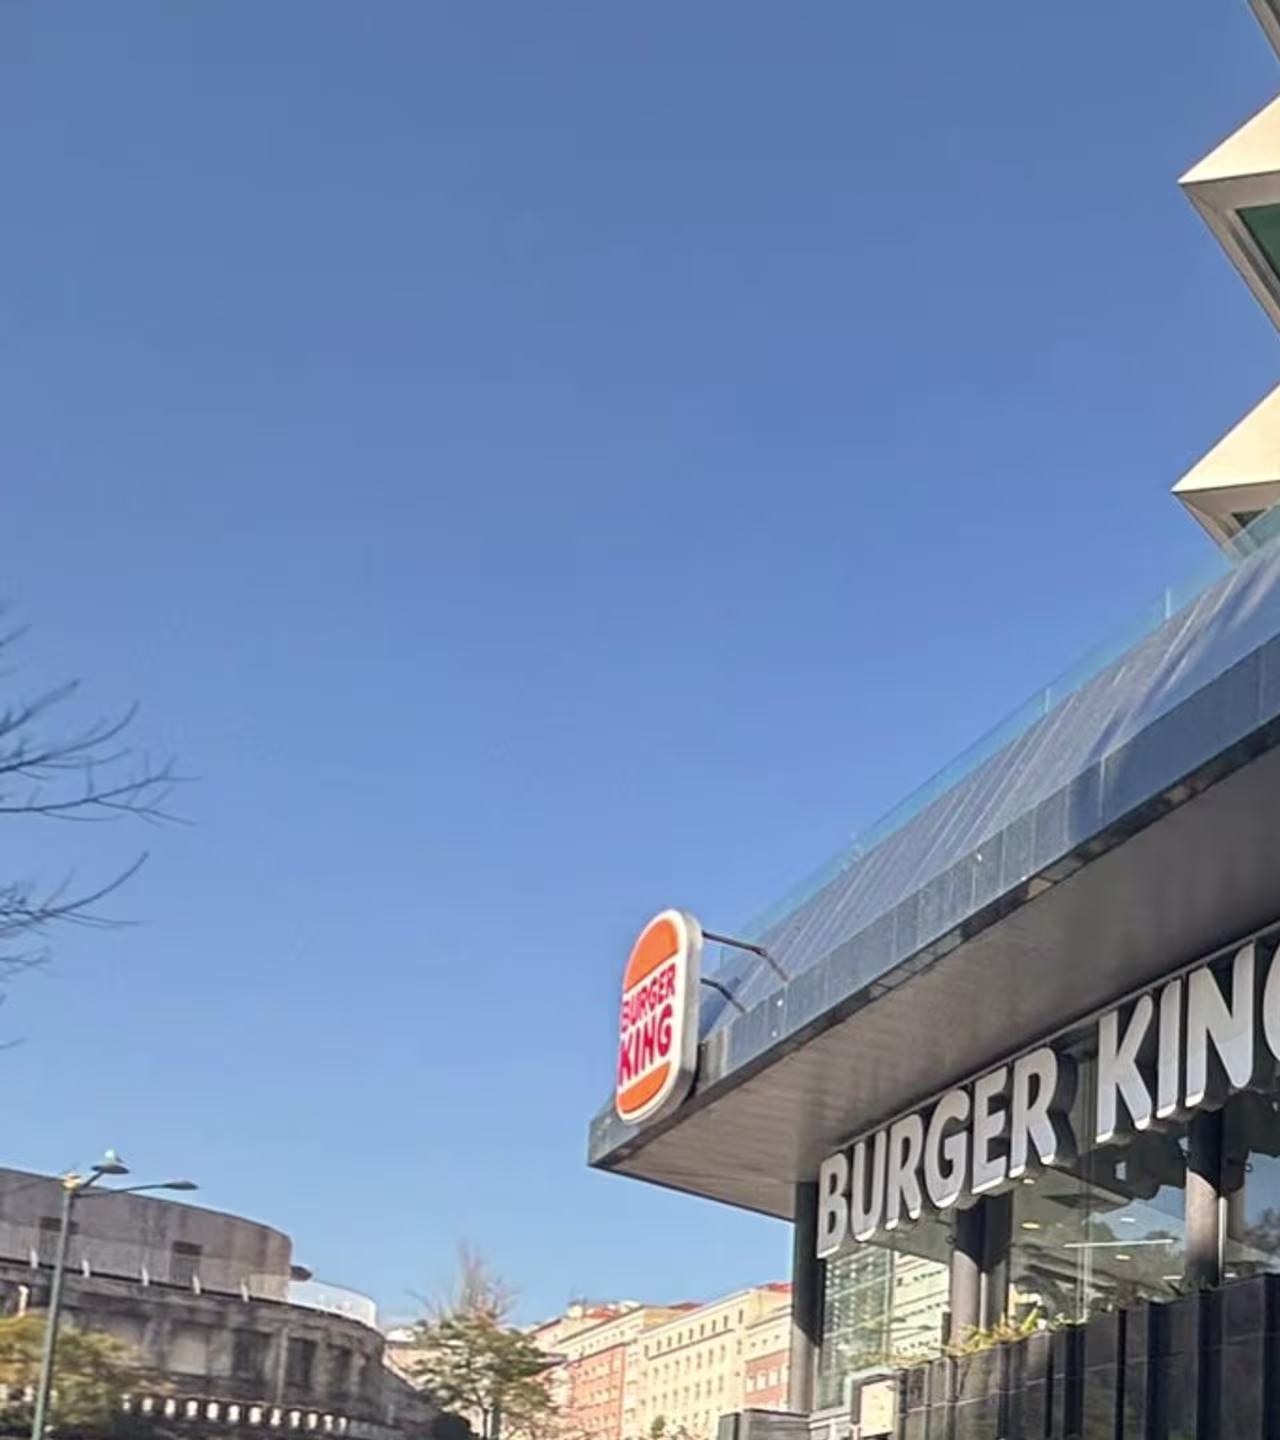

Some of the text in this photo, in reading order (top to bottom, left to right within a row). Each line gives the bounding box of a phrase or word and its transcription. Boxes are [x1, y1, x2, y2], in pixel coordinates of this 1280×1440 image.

[621, 962, 677, 1035] BURGER
[618, 1003, 674, 1086] KING
[817, 1046, 1059, 1259] BURGER
